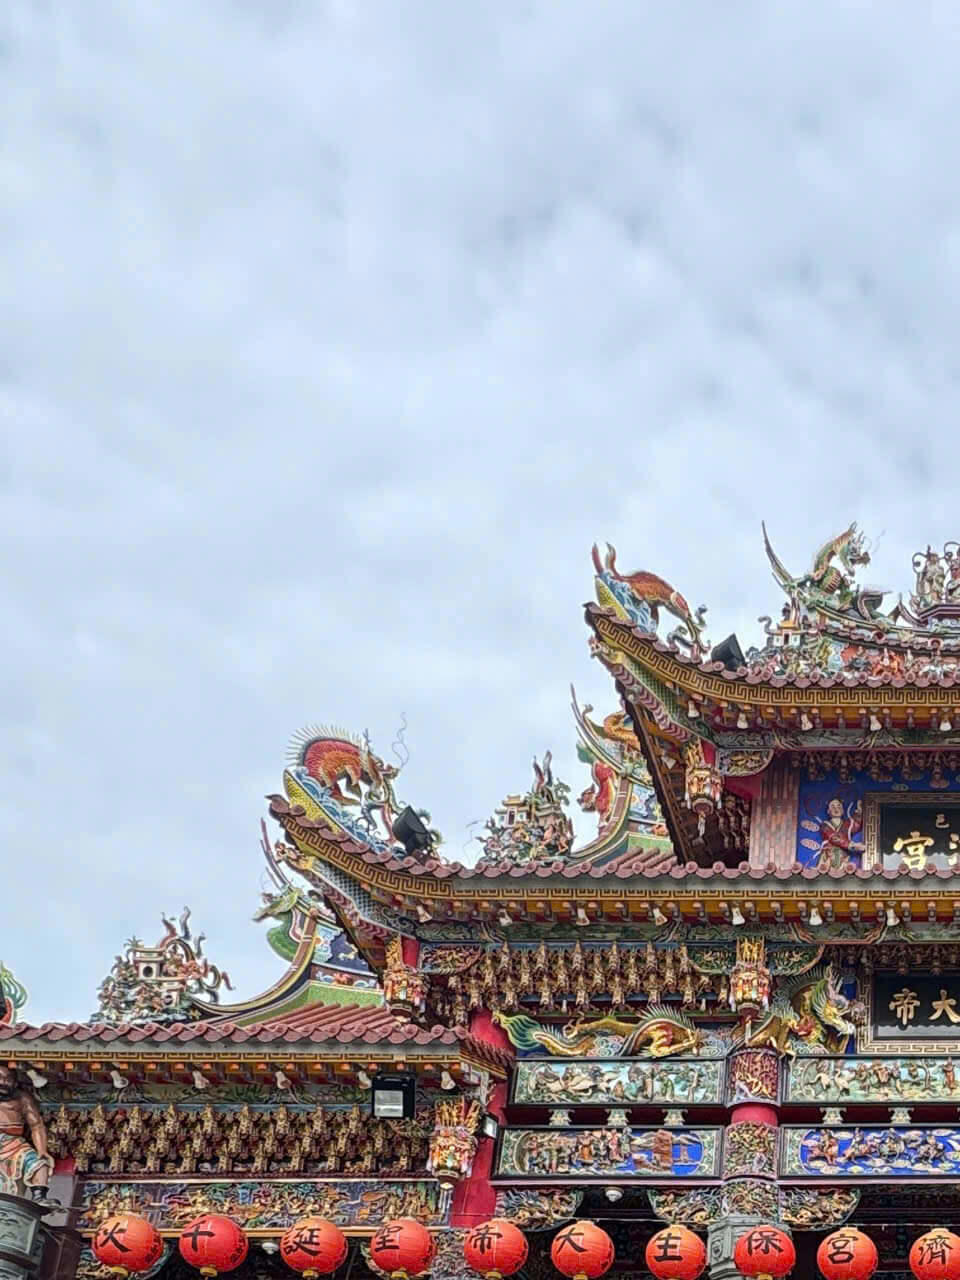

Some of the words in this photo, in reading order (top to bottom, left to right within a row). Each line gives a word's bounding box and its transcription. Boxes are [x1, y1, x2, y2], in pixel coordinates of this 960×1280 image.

[182, 1223, 215, 1254] 千
[285, 1224, 320, 1256] 誕
[373, 1222, 400, 1252] 聖
[468, 1223, 503, 1251] 帝
[555, 1222, 586, 1253] 大
[652, 1232, 684, 1262] 生
[747, 1230, 784, 1255] 保
[827, 1233, 855, 1265] 宮
[918, 1233, 955, 1265] 濟
